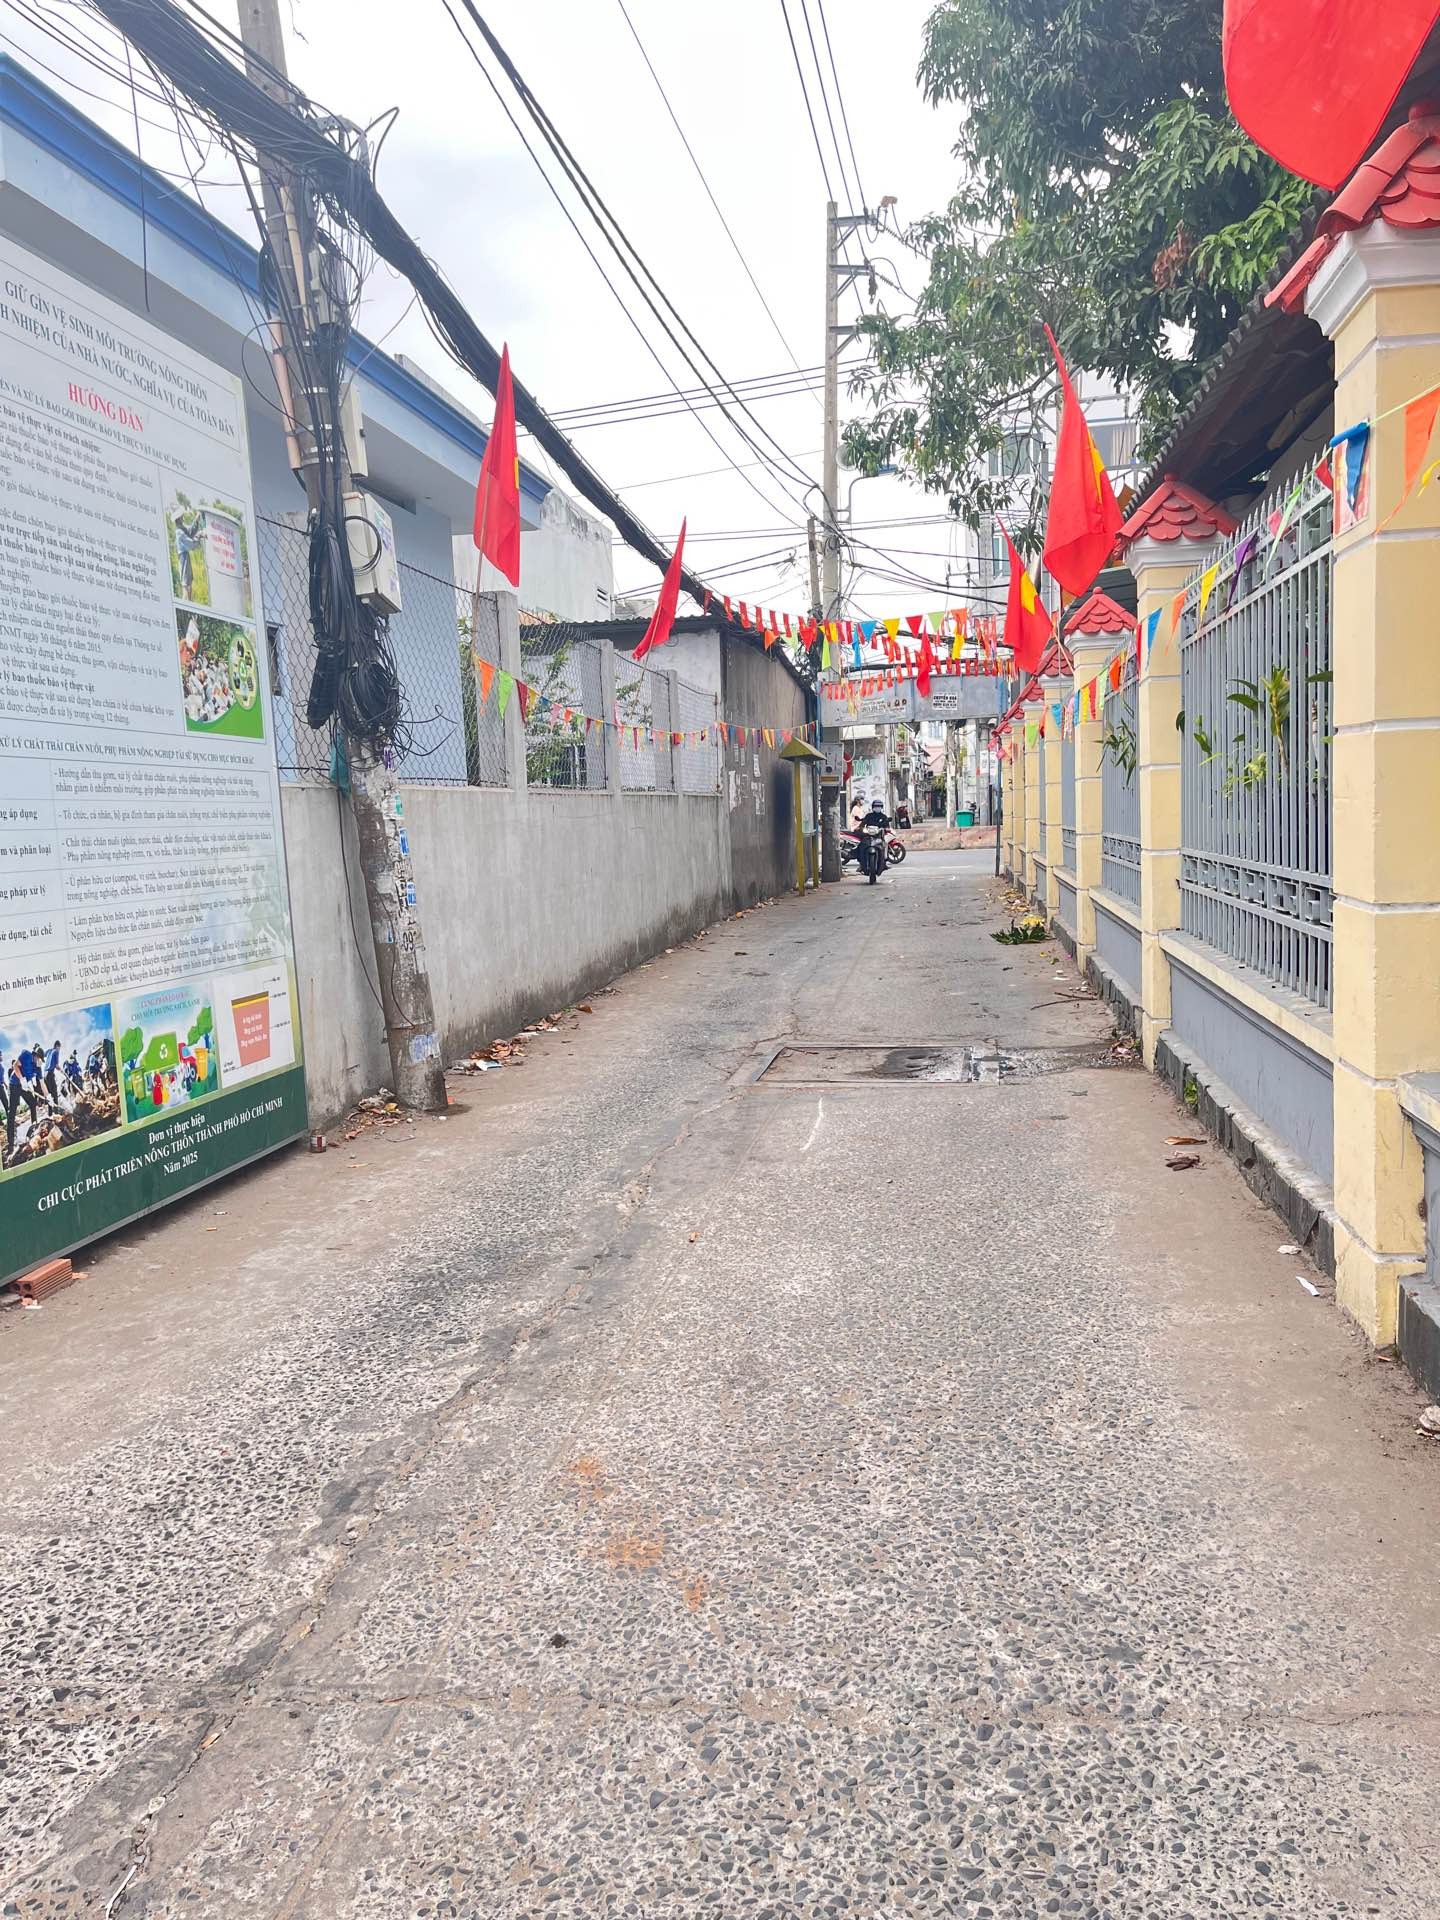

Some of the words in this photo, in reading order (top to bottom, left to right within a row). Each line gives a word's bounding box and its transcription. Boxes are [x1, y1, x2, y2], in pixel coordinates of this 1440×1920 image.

[5, 280, 27, 303] GIỮ
[30, 293, 50, 315] GÌN
[52, 305, 67, 328] VỆ
[69, 315, 93, 340] SINH
[96, 329, 116, 352] MÔI
[117, 341, 157, 375] TRƯỜNG
[158, 364, 183, 389] NÔNG
[184, 380, 207, 401] THÔN
[11, 309, 50, 341] NHIỆM
[52, 331, 75, 354] CỦA
[76, 343, 99, 367] NHÀ
[101, 355, 132, 384] NƯỚC,
[133, 372, 162, 399] NGHĨA
[163, 389, 175, 409] VỤ
[177, 398, 194, 417] CỦA
[195, 407, 217, 428] TOÀN
[218, 419, 234, 437] DÂN
[68, 382, 116, 420] HƯỚNG
[118, 406, 143, 432] DẪN
[9, 811, 18, 819] áp
[19, 809, 38, 820] dụng
[19, 845, 37, 856] phân
[38, 844, 51, 856] loại
[10, 888, 28, 899] pháp
[40, 885, 45, 896] lý
[8, 930, 29, 942] dụng,
[30, 929, 39, 937] tái
[41, 922, 52, 936] chế
[12, 977, 34, 989] nhiệm
[35, 975, 51, 985] thực
[53, 970, 67, 982] hiện
[149, 1131, 164, 1144] Đơn
[166, 1125, 173, 1139] vị
[174, 1121, 190, 1134] thực
[191, 1113, 205, 1127] hiện
[38, 1192, 59, 1211] CHI
[61, 1181, 83, 1201] CỤC
[86, 1169, 112, 1191] PHÁT
[114, 1156, 142, 1178] TRIỂN
[144, 1145, 169, 1163] NÔNG
[171, 1134, 194, 1153] THÔN
[195, 1122, 222, 1142] THÀNH
[223, 1113, 239, 1131] PHỐ
[240, 1110, 250, 1124] HỒ
[251, 1102, 264, 1118] CHÍ
[265, 1097, 282, 1111] MINH
[164, 1162, 181, 1176] Năm
[182, 1151, 198, 1167] 2025
